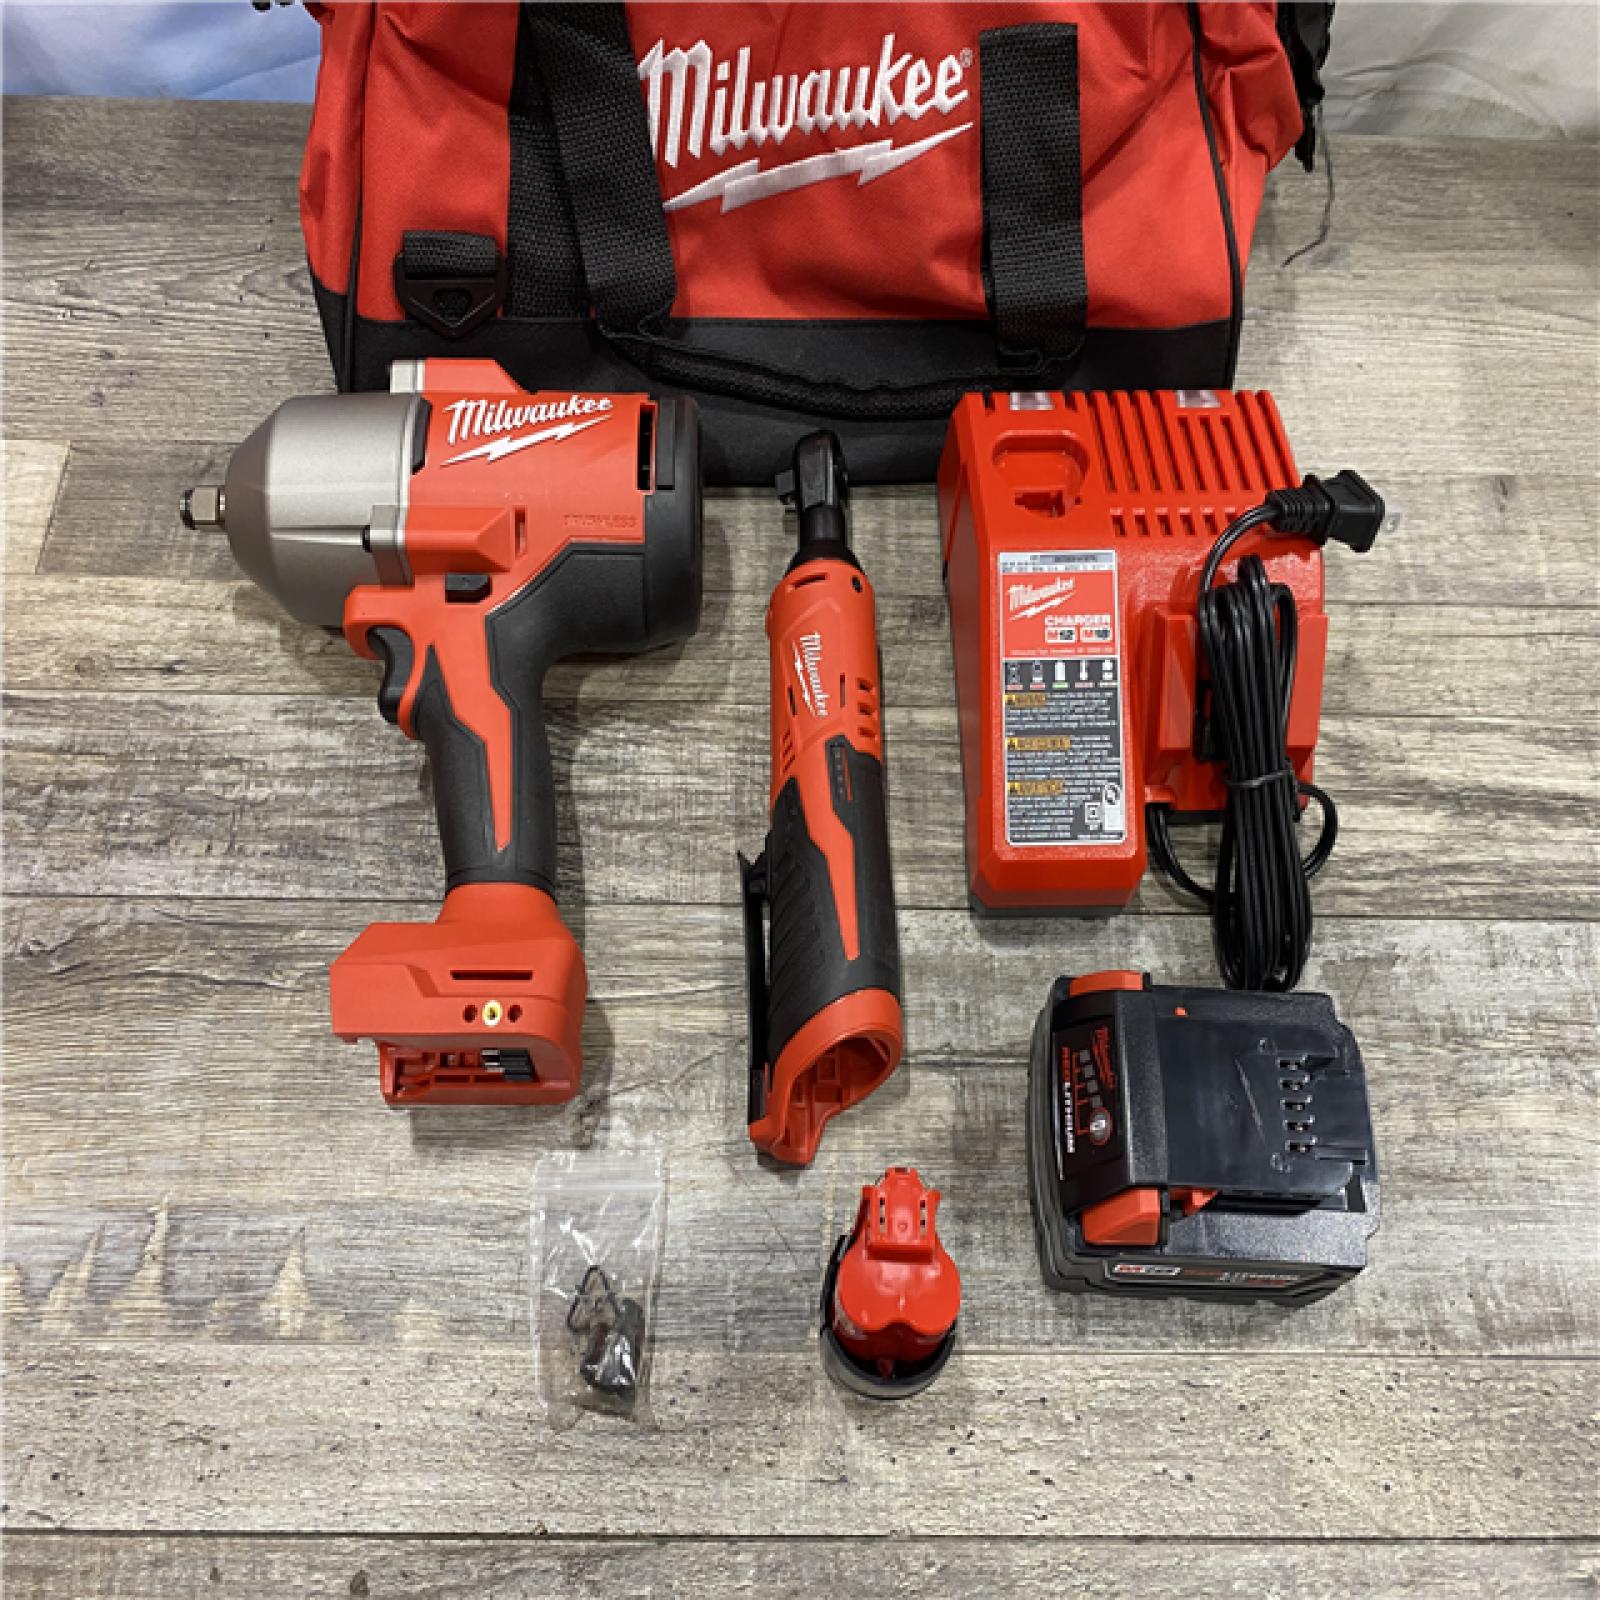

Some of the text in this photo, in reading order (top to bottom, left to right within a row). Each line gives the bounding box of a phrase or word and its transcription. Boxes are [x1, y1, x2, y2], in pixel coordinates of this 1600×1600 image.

[637, 32, 968, 168] Milwaukee
[443, 394, 613, 446] Milwaukee
[1045, 614, 1111, 626] CHARGER
[799, 632, 830, 716] Milwaukee
